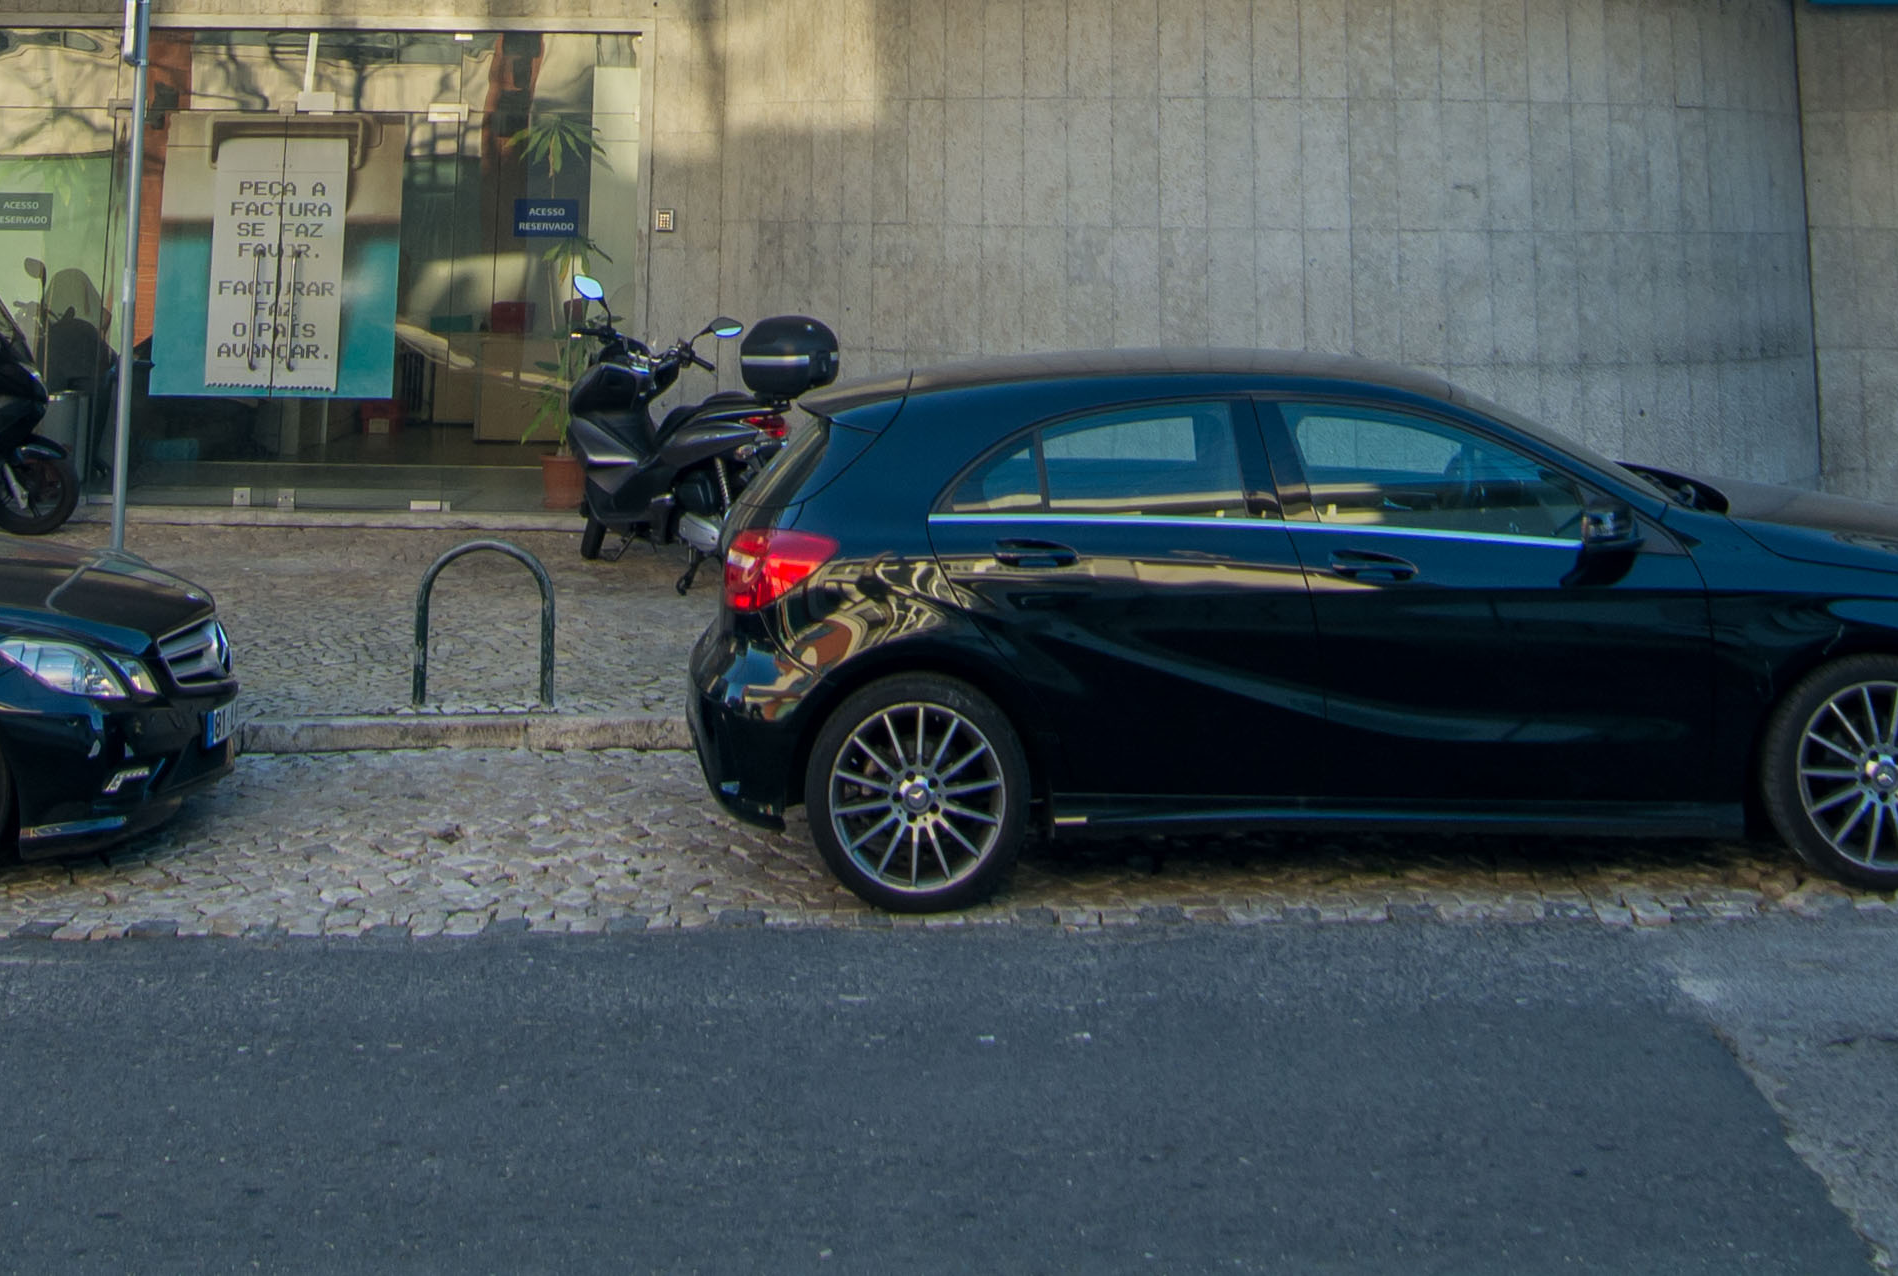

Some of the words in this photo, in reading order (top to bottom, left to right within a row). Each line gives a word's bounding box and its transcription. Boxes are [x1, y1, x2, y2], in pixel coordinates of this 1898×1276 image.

[239, 181, 297, 200] PEÇA
[312, 182, 326, 196] A
[3, 201, 39, 210] ACESSO
[230, 201, 332, 217] FACTURA
[528, 207, 566, 217] ACESSO
[236, 222, 266, 237] SE
[282, 223, 324, 238] FAZ
[518, 222, 575, 231] RESERVADO
[218, 280, 335, 297] FACTRAR
[232, 322, 247, 337] O
[216, 342, 329, 365] AVANÇAR.
